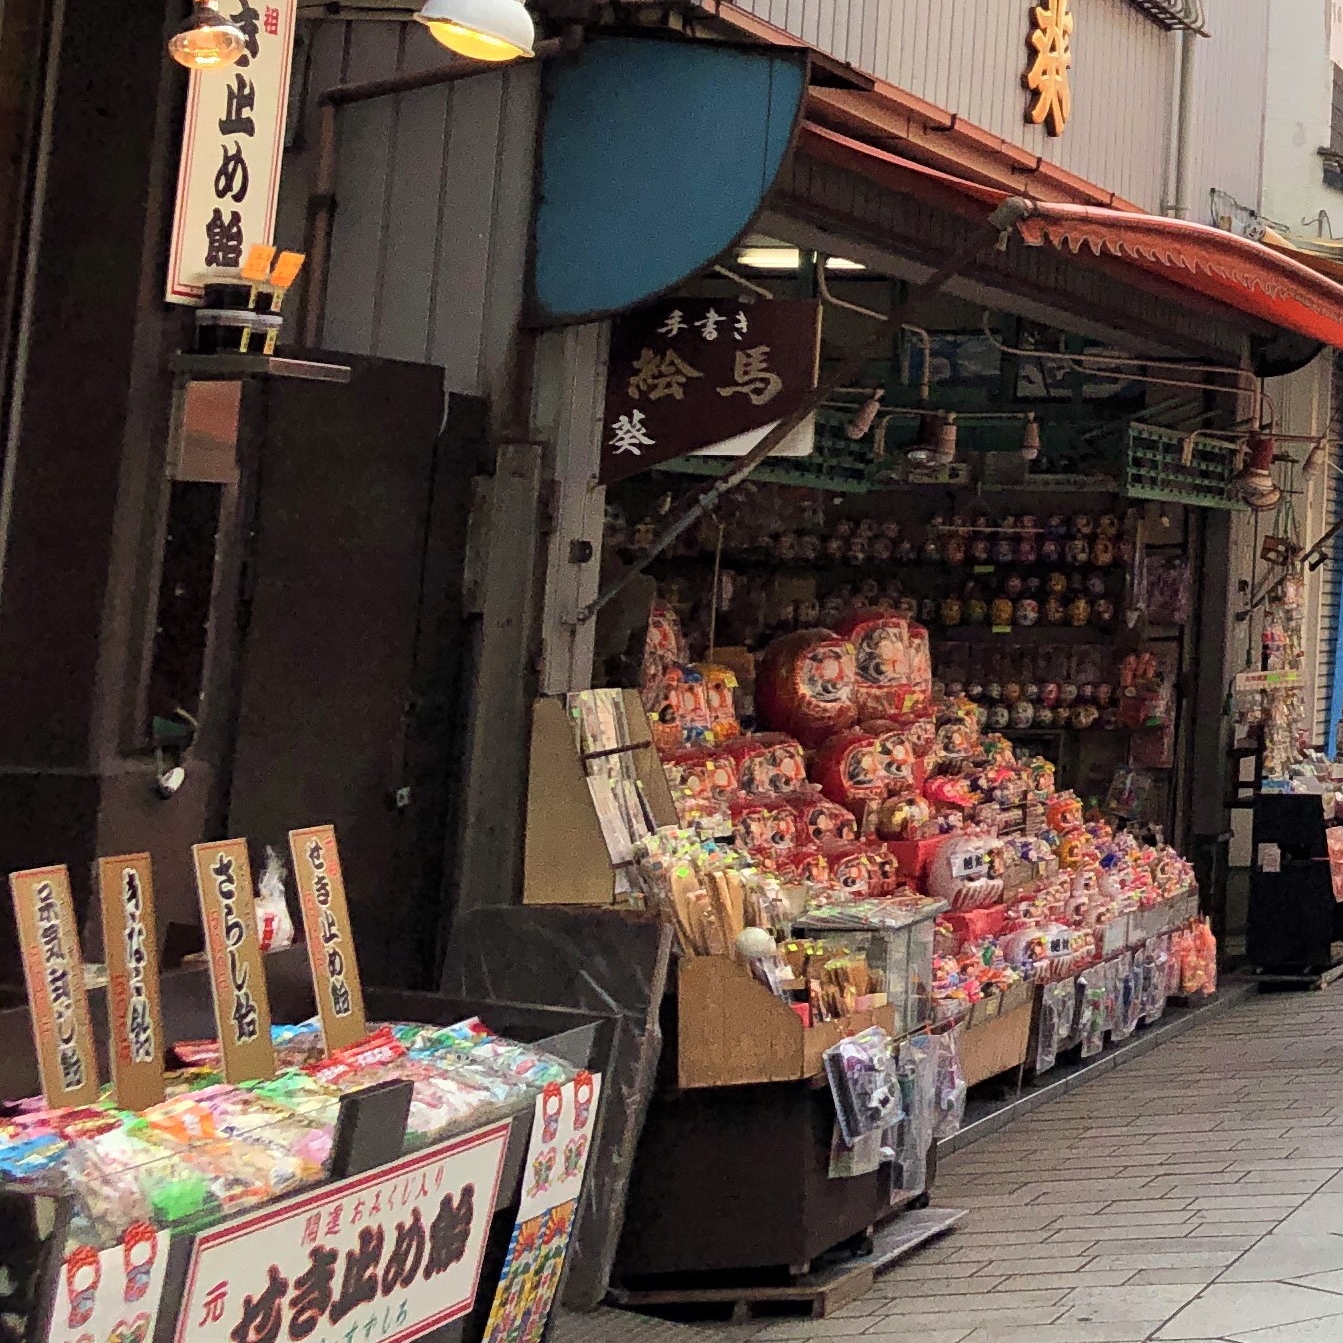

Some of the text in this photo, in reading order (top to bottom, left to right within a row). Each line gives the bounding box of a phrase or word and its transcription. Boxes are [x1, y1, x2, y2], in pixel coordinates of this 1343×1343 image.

[627, 345, 782, 405] 絵馬
[657, 308, 748, 340] 手書き
[608, 409, 656, 456] 葵
[210, 852, 259, 1044] さらし飴
[306, 837, 351, 1018] せき止め飴
[230, 1182, 475, 1343] せき止め飴
